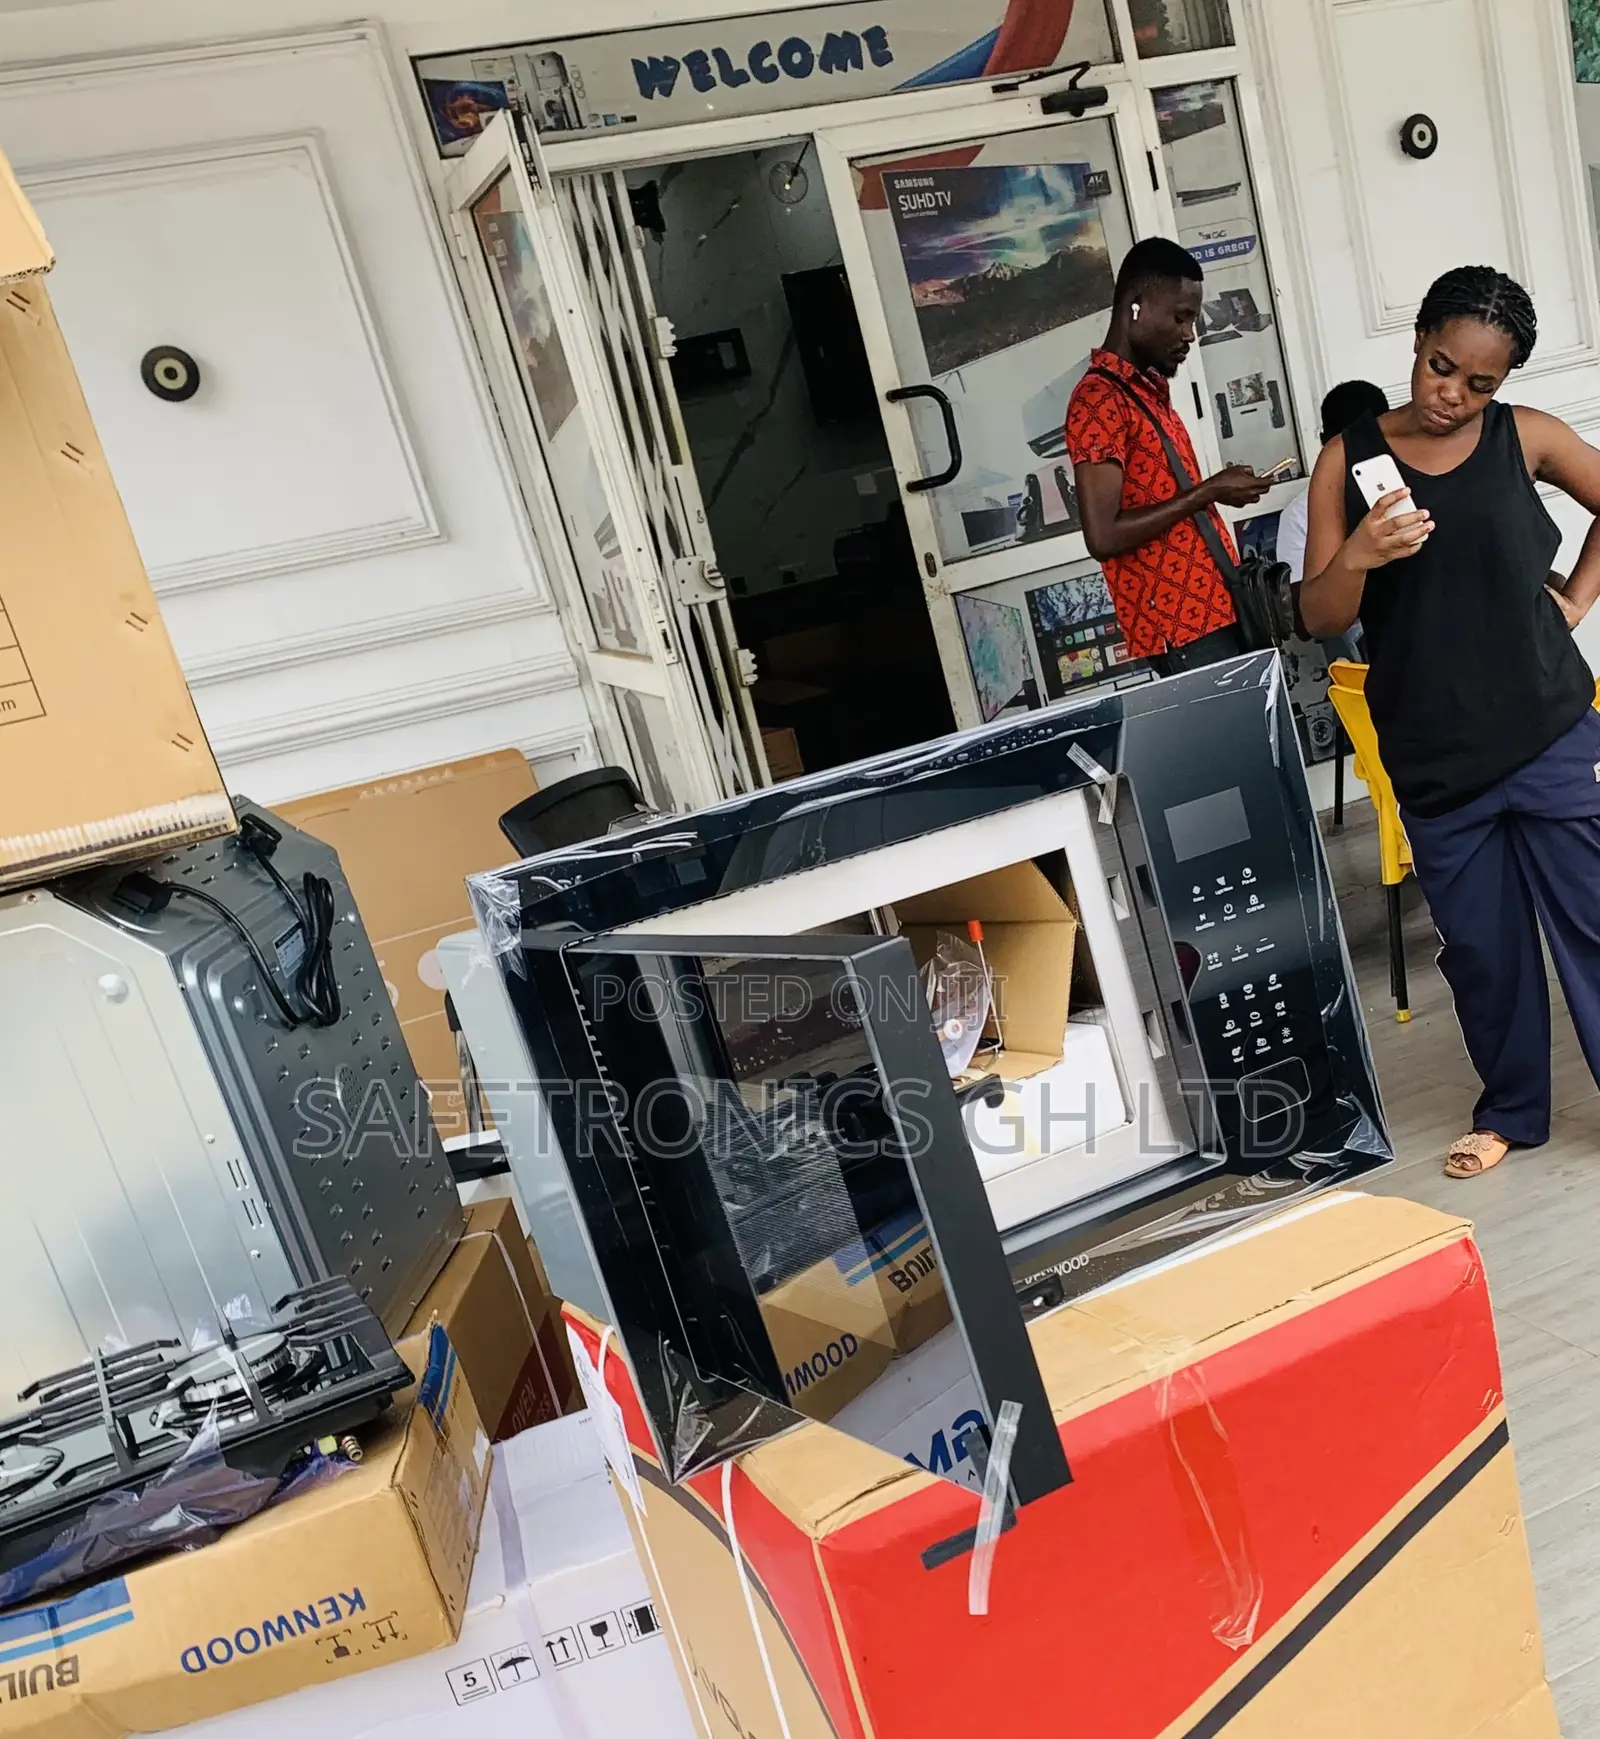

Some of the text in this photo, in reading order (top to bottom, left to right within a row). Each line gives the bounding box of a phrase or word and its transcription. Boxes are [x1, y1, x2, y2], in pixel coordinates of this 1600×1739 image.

[630, 25, 894, 100] WELCOME
[894, 177, 935, 189] SAMSUNG
[1205, 246, 1215, 258] IS
[1217, 241, 1251, 257] GREAT
[180, 1587, 367, 1675] KENWOOD
[0, 1654, 80, 1702] BUIL
[463, 1671, 477, 1687] 5
